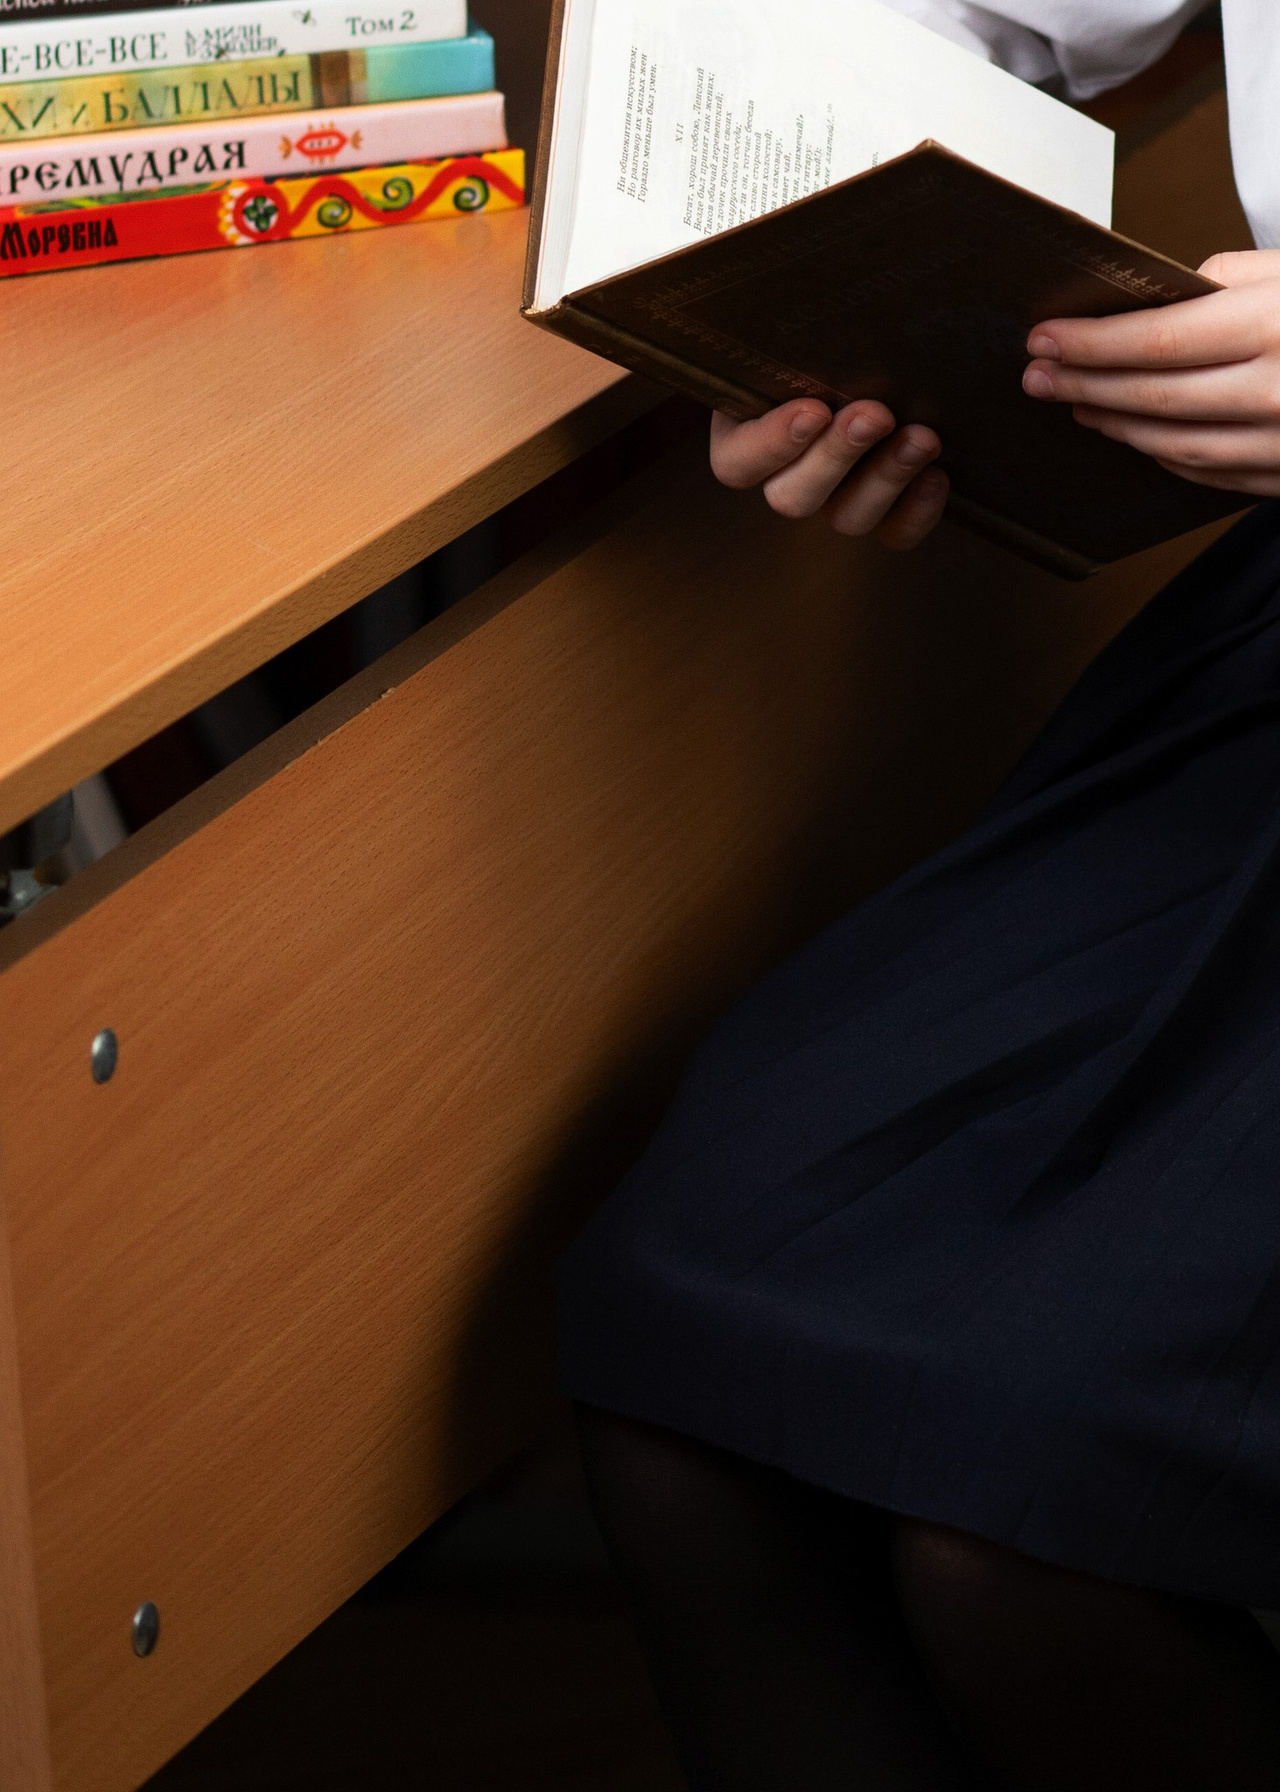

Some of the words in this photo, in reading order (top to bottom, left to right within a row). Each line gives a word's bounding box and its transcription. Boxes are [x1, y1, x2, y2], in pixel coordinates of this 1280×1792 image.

[399, 10, 417, 31] 2
[1, 32, 168, 75] Е-ВСЕ-ВСЕ
[101, 70, 302, 123] БАЛЛАДЫ
[626, 46, 638, 110] искусством;
[637, 78, 646, 115] милых
[649, 63, 657, 93] умен.
[635, 117, 642, 131] их
[646, 94, 654, 115] был
[620, 112, 632, 174] общежития
[644, 117, 653, 159] меньше
[688, 155, 697, 189] хорош
[693, 67, 704, 114] Ленский
[724, 111, 732, 141] своих
[0, 140, 247, 194] РЕМУДРАЯ
[631, 133, 641, 180] разговор
[699, 135, 710, 175] принят
[720, 144, 730, 188] прочили
[741, 193, 747, 206] ли
[745, 99, 754, 133] беседа
[753, 132, 762, 180] стороной
[617, 176, 626, 193] Ни
[627, 183, 636, 198] Но
[637, 161, 649, 203] Гораздо
[697, 177, 705, 199] был
[707, 164, 717, 203] обычай
[750, 182, 758, 212] слово
[694, 201, 704, 231] Везде
[704, 205, 714, 235] Таков
[717, 191, 726, 221] дочек
